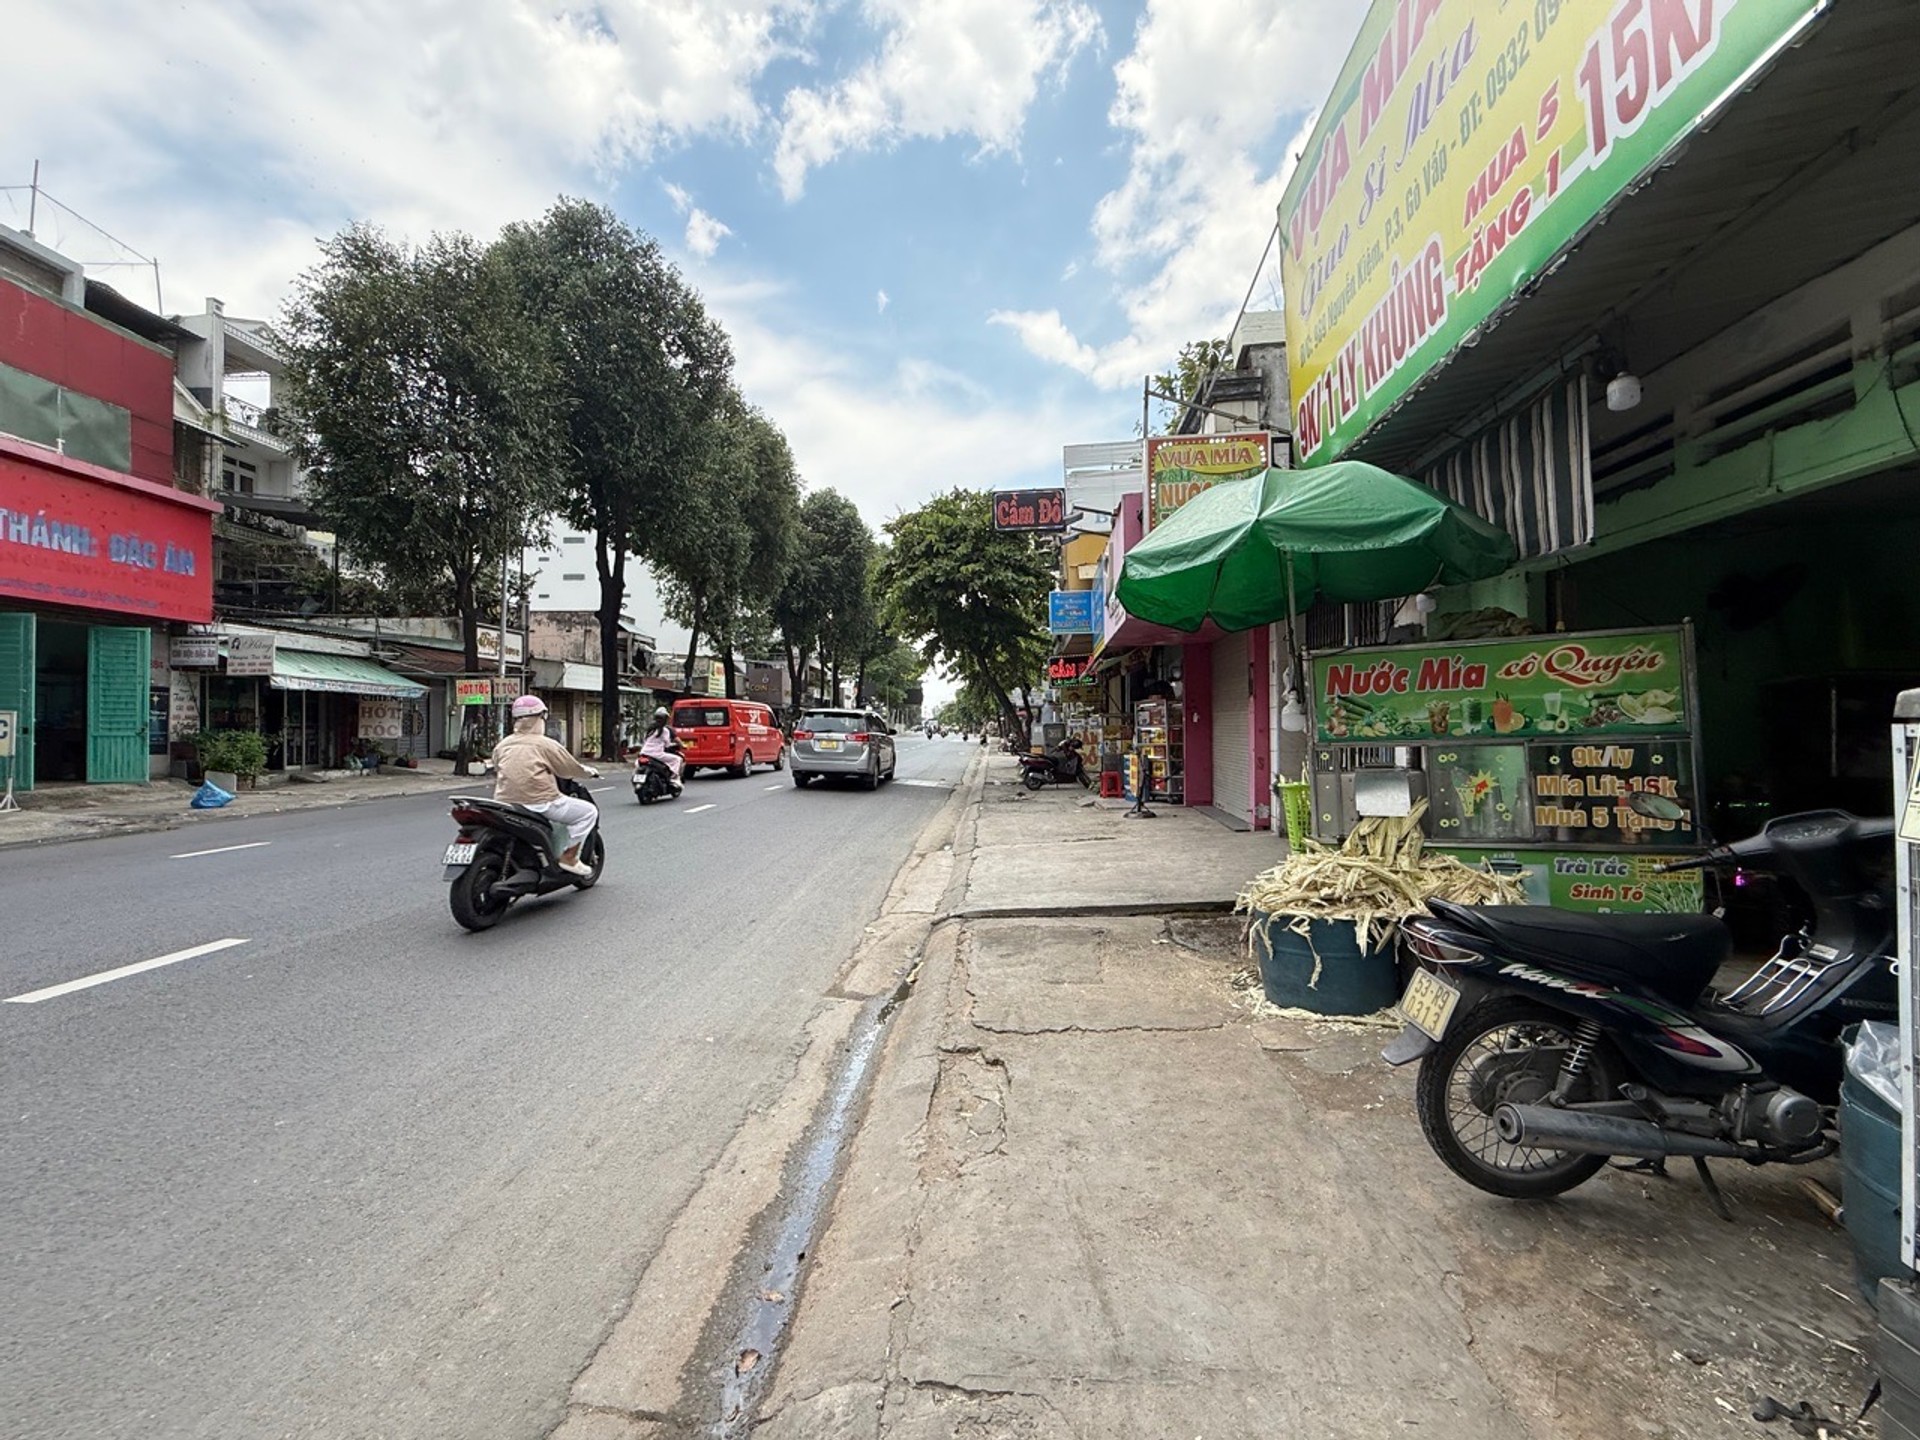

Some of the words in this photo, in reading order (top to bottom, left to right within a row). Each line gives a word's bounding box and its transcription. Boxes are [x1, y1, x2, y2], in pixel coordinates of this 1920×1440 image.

[1486, 20, 1530, 110] 0932
[1463, 125, 1527, 230] MUA
[1536, 78, 1560, 142] 5
[1454, 187, 1531, 295] TẶNG
[1545, 148, 1560, 200] 1
[1337, 339, 1358, 419] LY
[1362, 239, 1446, 393] KHỦNG
[1326, 658, 1411, 697] Nước
[1415, 653, 1488, 692] Mía
[1496, 651, 1541, 679] cô
[1543, 643, 1666, 687] Quyên
[1571, 746, 1634, 769] 9k/ly
[1537, 774, 1584, 796] Mía
[1592, 806, 1609, 828] 5
[1555, 858, 1588, 874] Trà
[1593, 856, 1628, 876] Tắc
[1571, 884, 1615, 900] Sinh
[1621, 883, 1646, 901] Tố
